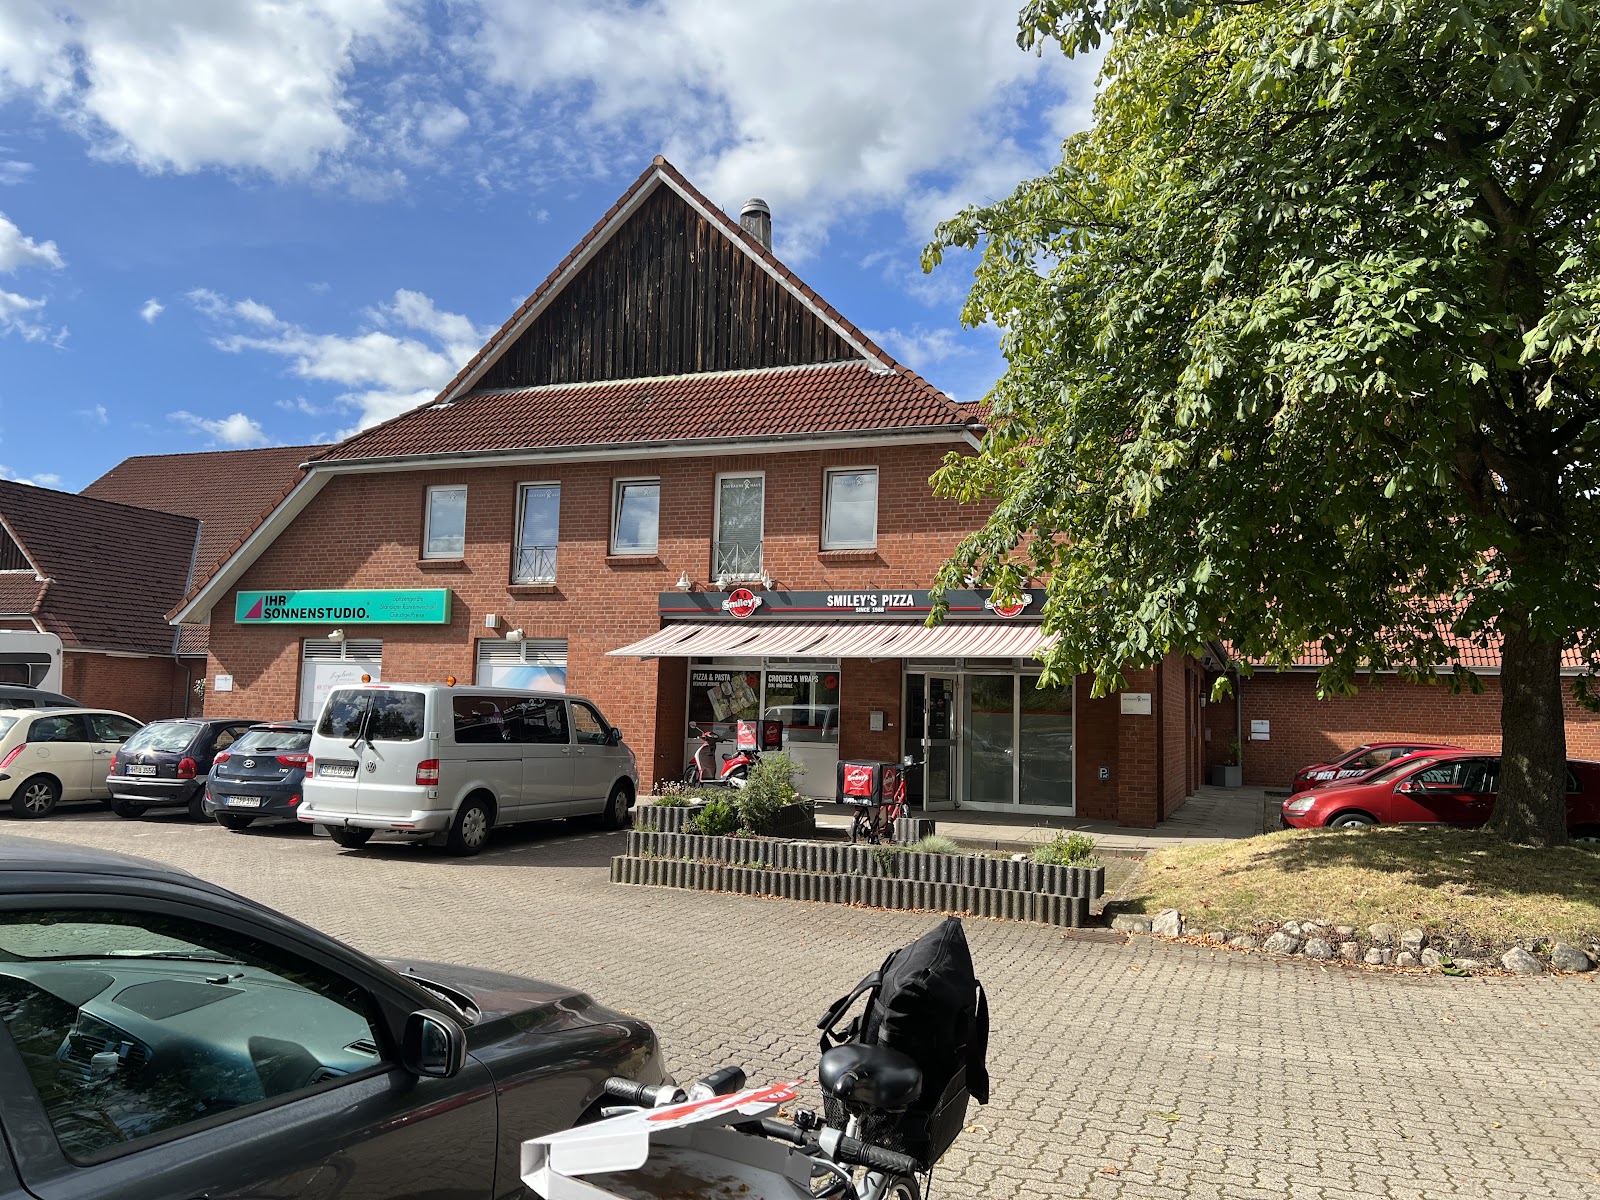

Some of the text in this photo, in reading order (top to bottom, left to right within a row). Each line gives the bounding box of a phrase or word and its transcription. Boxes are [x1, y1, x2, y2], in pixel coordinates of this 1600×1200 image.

[265, 595, 287, 606] IHR
[826, 594, 914, 607] SMILEY'S PIZZA
[692, 672, 731, 682] PIZZA & PASTA
[768, 674, 819, 683] CROQUES & WRAPS
